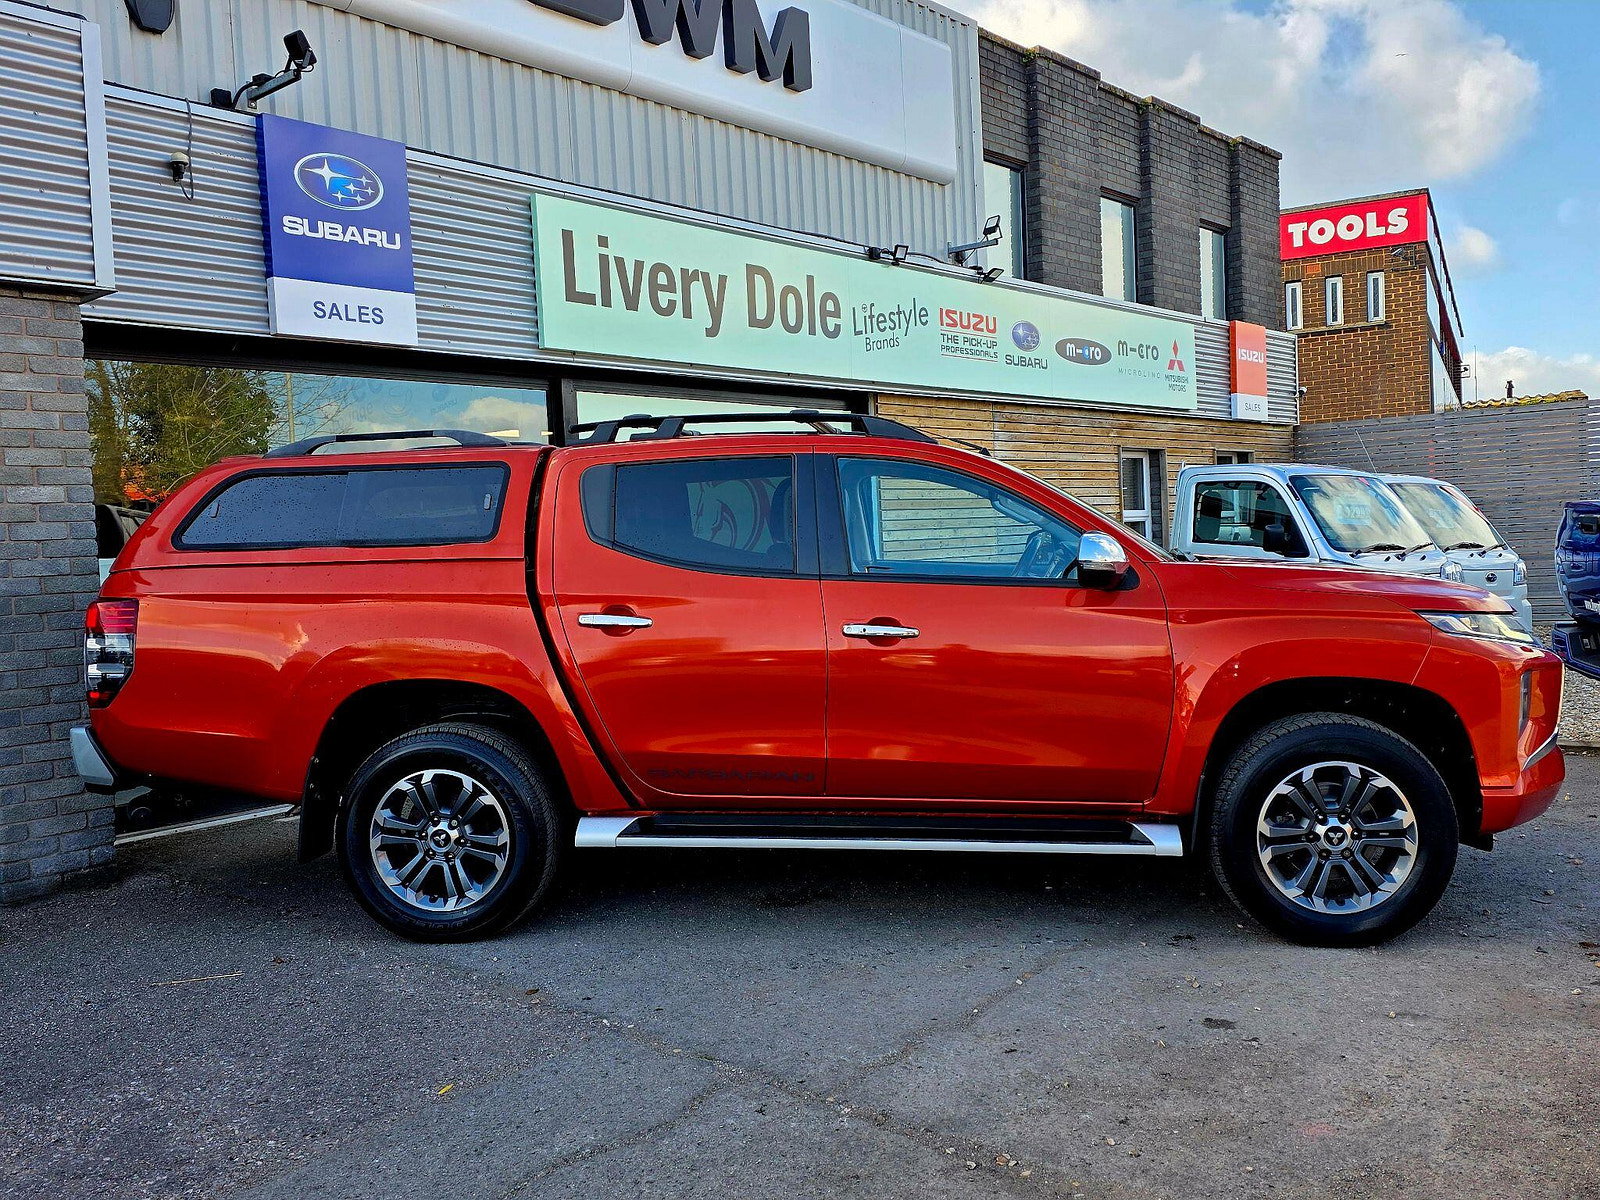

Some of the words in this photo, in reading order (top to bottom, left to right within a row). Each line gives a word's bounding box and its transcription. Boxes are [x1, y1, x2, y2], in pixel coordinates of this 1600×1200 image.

[524, 0, 813, 93] WM
[282, 215, 401, 250] SUBARU
[1287, 207, 1409, 248] TOOLS
[561, 228, 728, 338] Livery
[745, 263, 842, 340] Dole
[313, 300, 385, 325] SALES
[852, 297, 929, 337] Lifestyle
[939, 307, 997, 334] ISUZU
[865, 331, 900, 352] Brands
[940, 333, 959, 345] THE
[963, 336, 998, 350] PICK-UP
[940, 345, 998, 359] PROFESSIONALS
[1005, 354, 1048, 370] SUBARU
[1238, 348, 1264, 364] ISUZU
[1244, 402, 1261, 412] SALES
